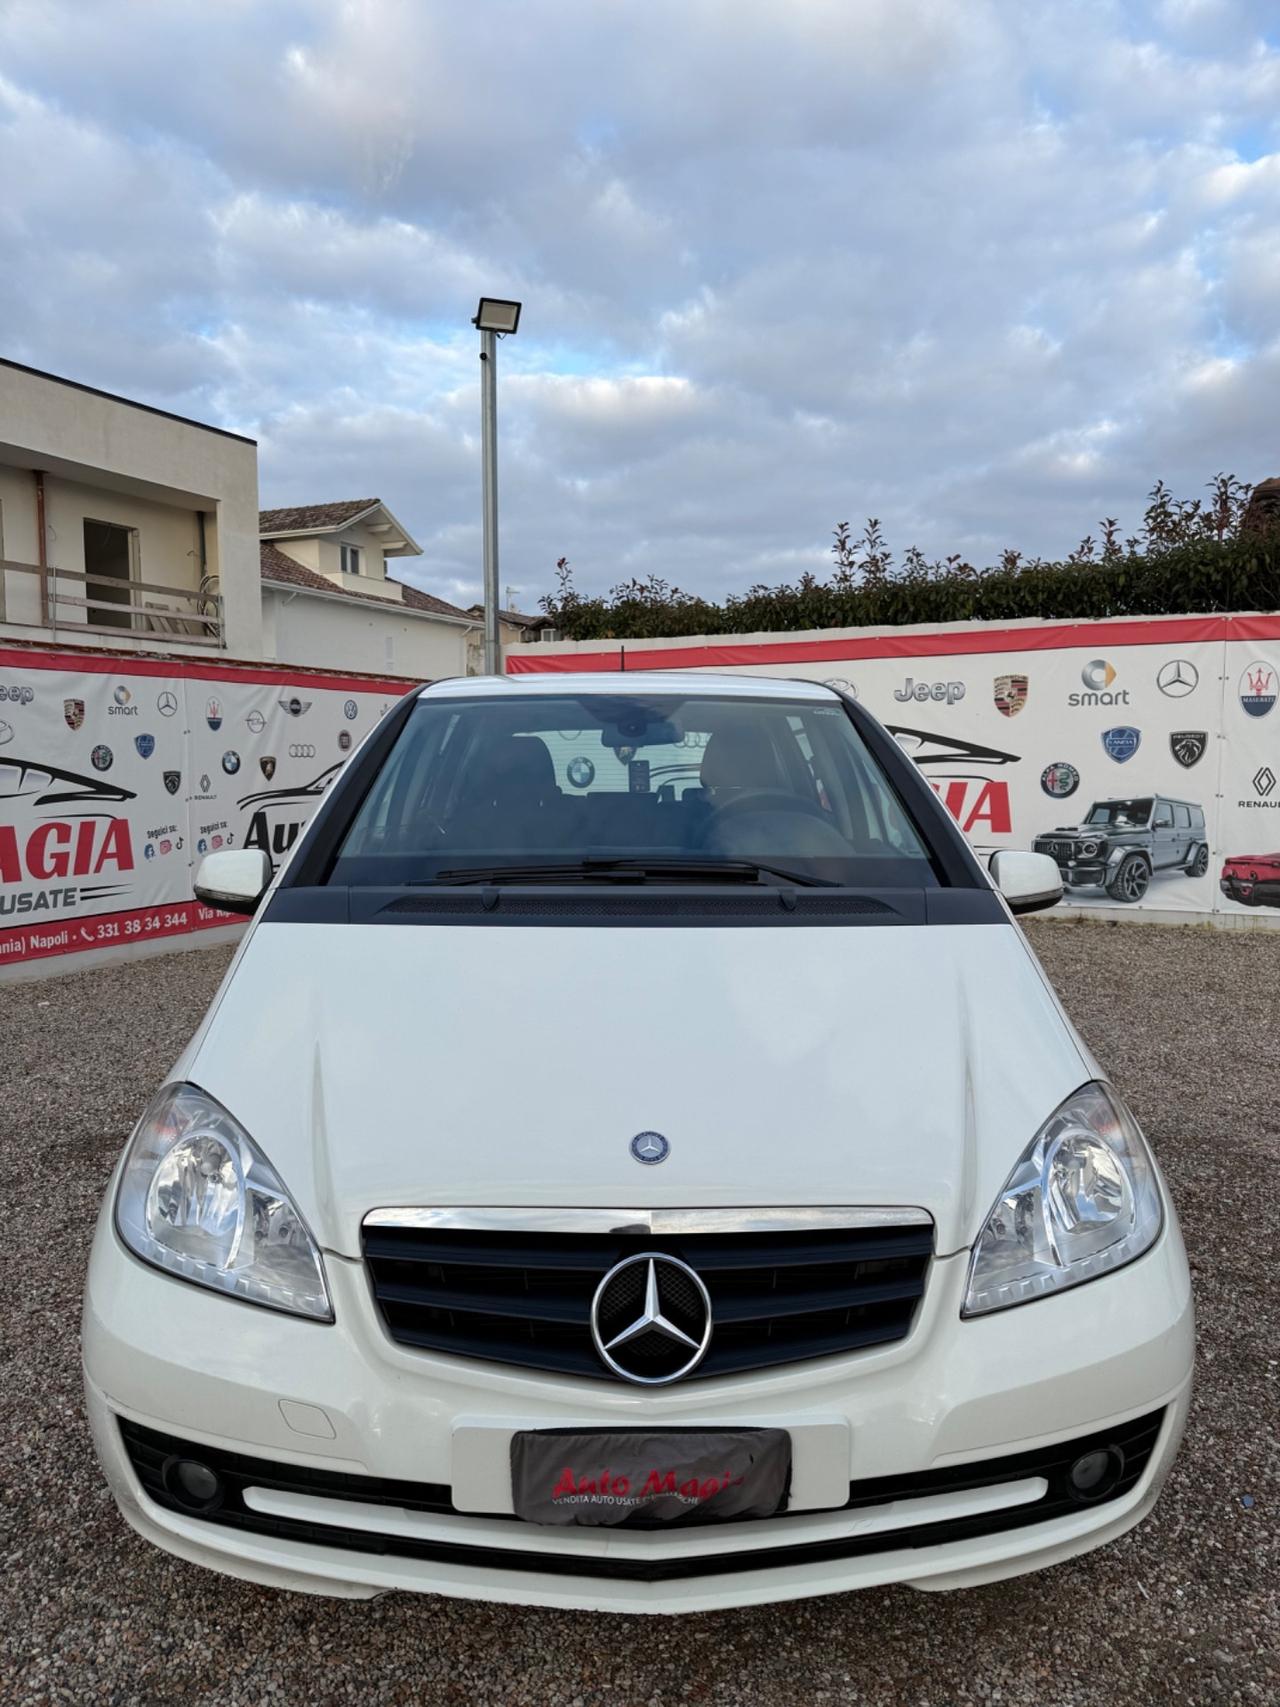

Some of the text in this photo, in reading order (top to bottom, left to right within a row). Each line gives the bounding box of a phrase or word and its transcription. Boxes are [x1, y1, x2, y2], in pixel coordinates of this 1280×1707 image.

[894, 677, 966, 704] Jeep
[1068, 689, 1130, 706] smart
[108, 705, 138, 716] smart
[932, 782, 1012, 832] IA
[242, 811, 306, 854] Au
[0, 888, 77, 915] USATE
[198, 907, 213, 920] Via
[0, 912, 188, 954] nia) Napoli 331 38 34 344
[552, 1467, 631, 1497] Auto
[552, 1495, 589, 1505] VENDITA
[590, 1495, 615, 1505] AUTO
